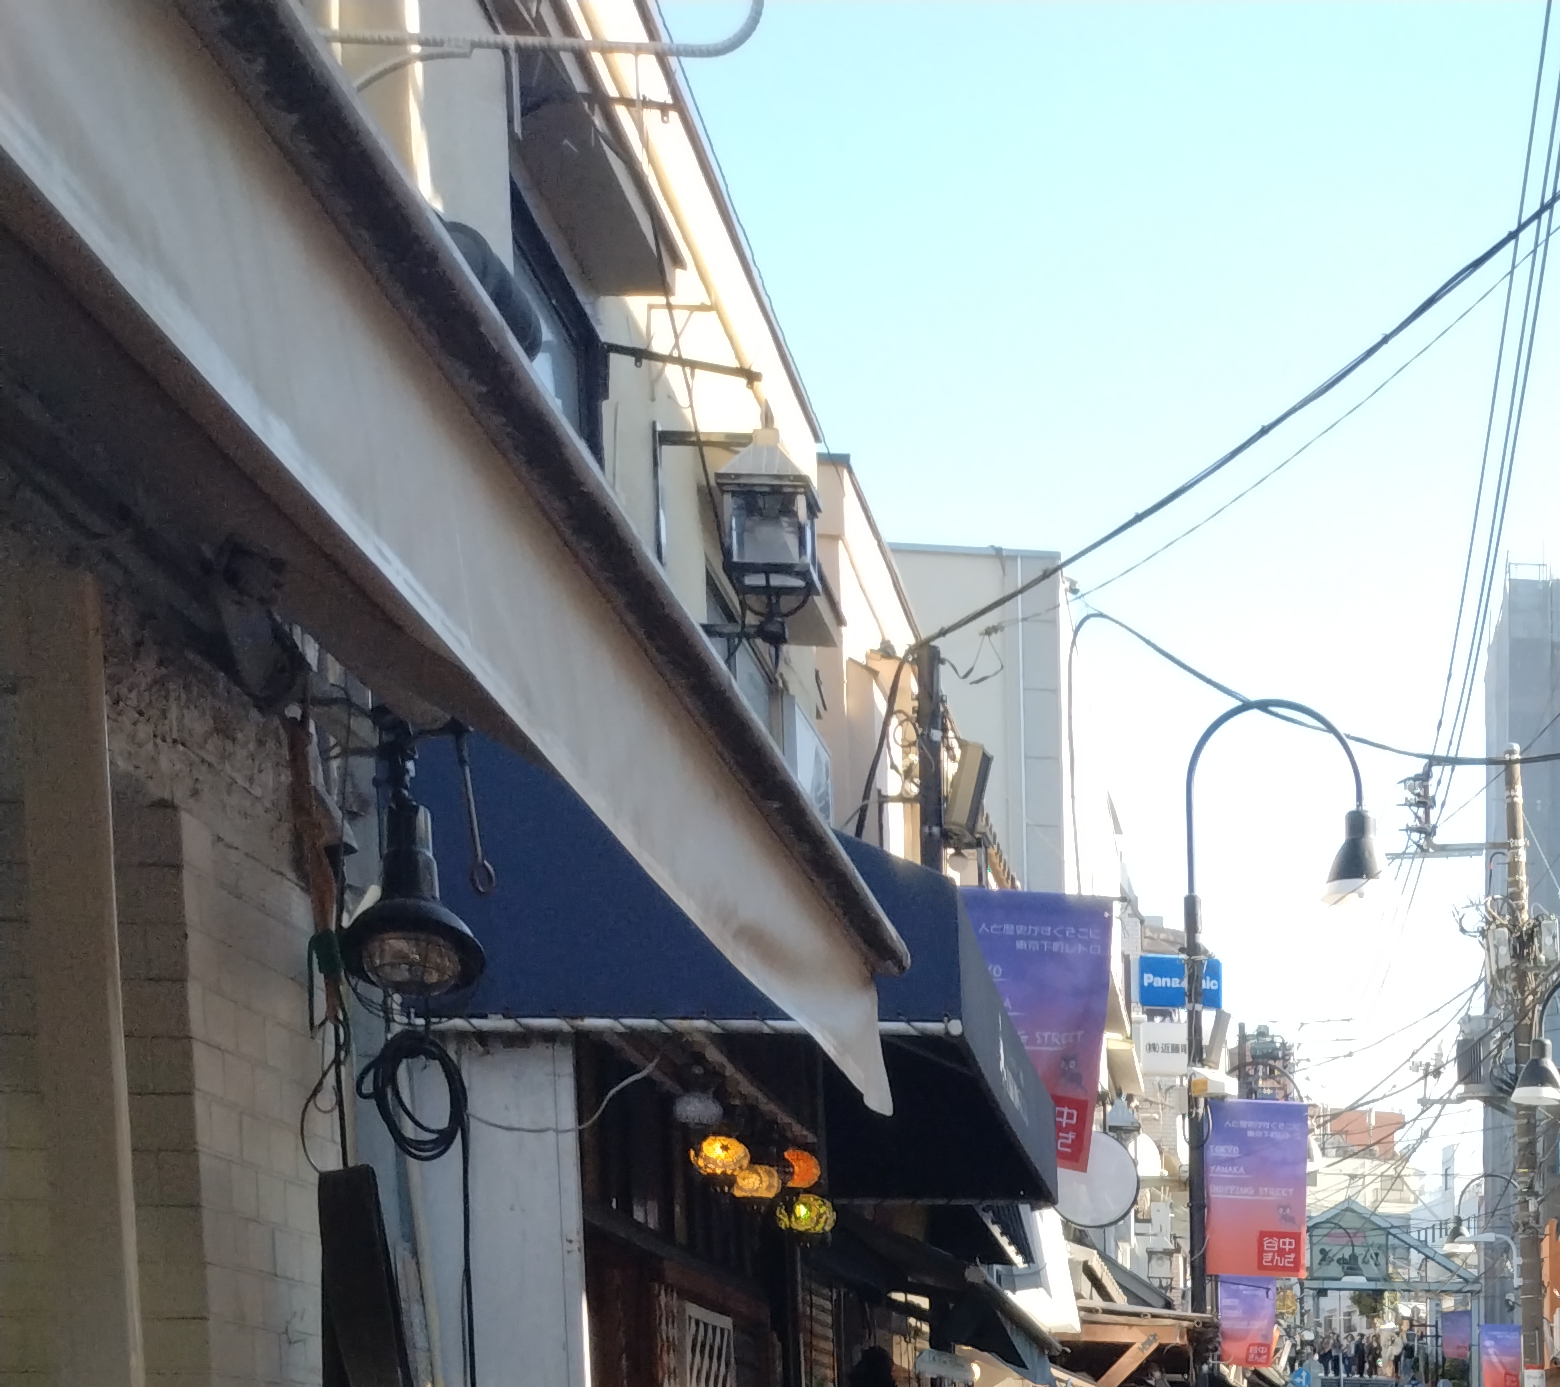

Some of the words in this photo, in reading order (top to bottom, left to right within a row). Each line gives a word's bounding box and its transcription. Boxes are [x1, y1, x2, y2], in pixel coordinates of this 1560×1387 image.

[1208, 1145, 1240, 1154] TOKYO
[1209, 1165, 1246, 1175] YANAKA
[1262, 1236, 1296, 1252] 谷中
[1262, 1252, 1296, 1267] ぎんざ
